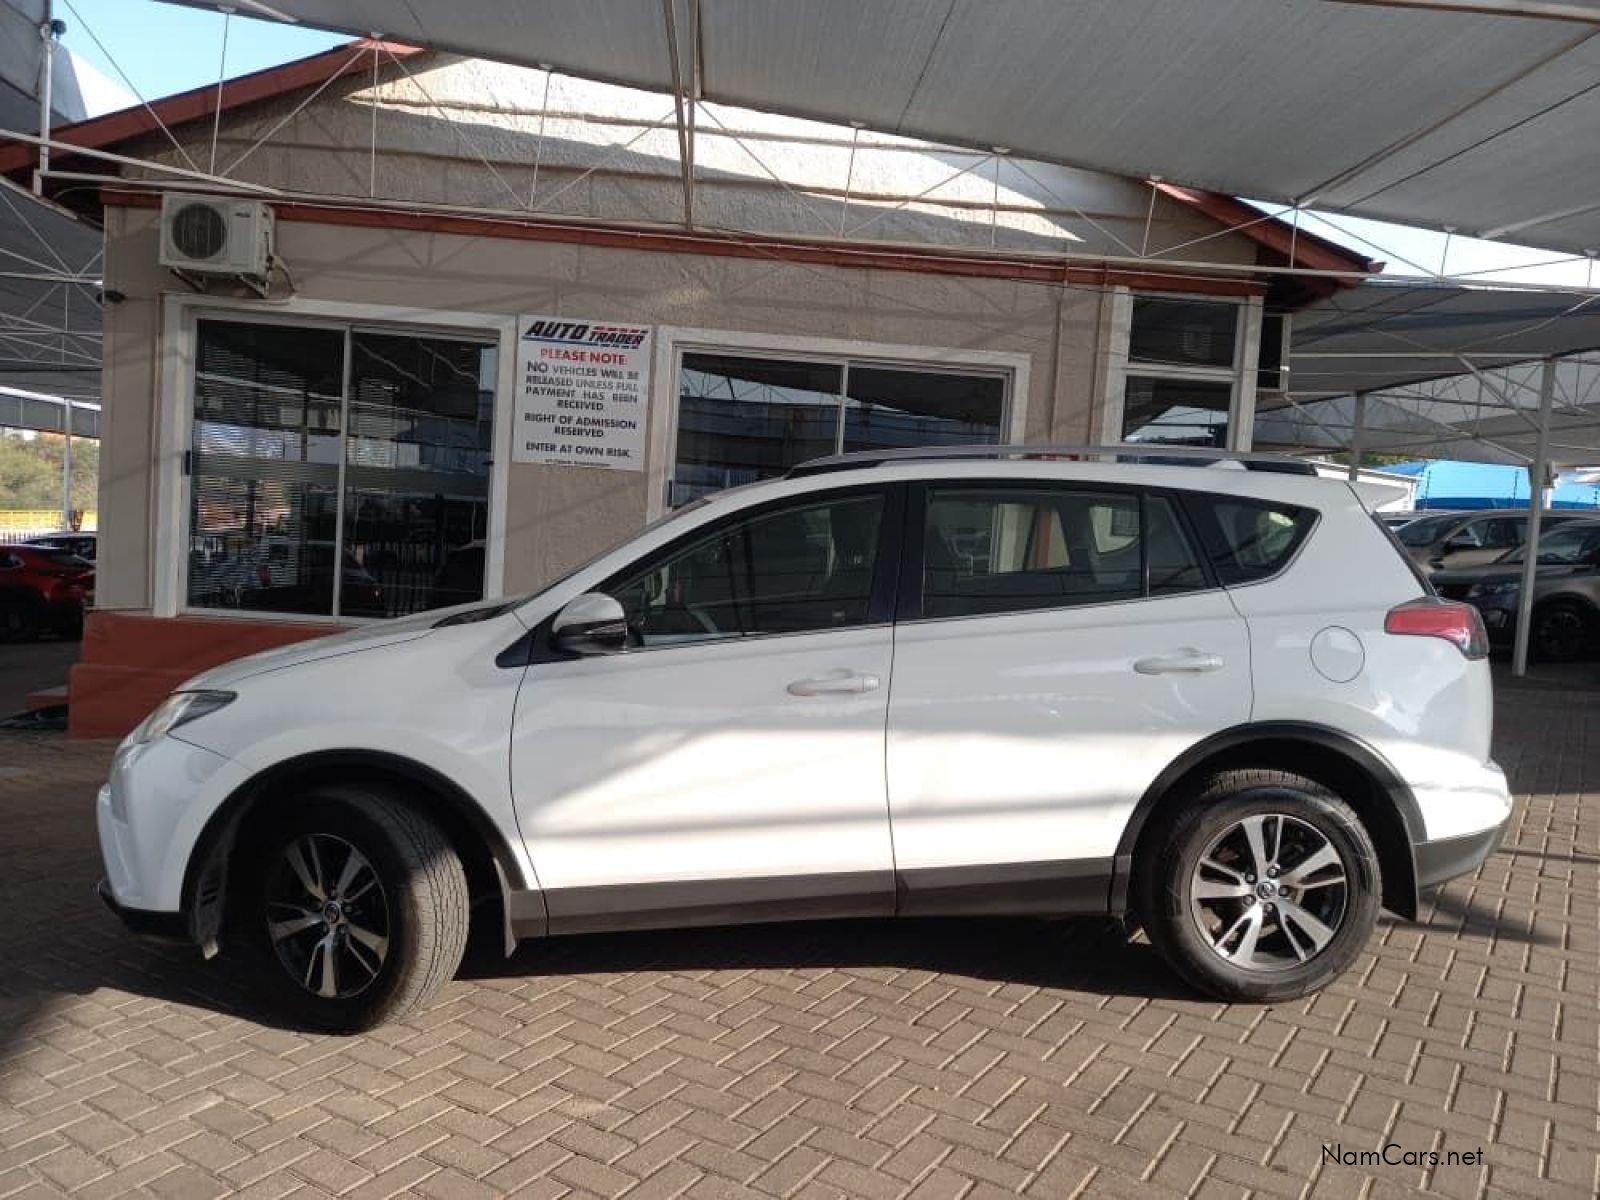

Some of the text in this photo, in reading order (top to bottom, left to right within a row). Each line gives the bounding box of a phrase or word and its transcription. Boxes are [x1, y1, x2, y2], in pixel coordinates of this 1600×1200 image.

[525, 321, 646, 345] AUTO TRADER
[540, 348, 587, 361] PLEASE
[527, 361, 640, 380] NO VEHICLES WILL BE
[526, 375, 638, 392] RELEASED UNLESS FULL
[526, 386, 638, 403] PAYMENT HAS BEEN
[557, 399, 604, 411] RECEIVED
[525, 412, 636, 430] RIGHT OF ADMISSION
[555, 426, 604, 438] RESERVED
[526, 441, 557, 452] ENTER
[560, 444, 573, 453] AT
[575, 446, 604, 457] OWN
